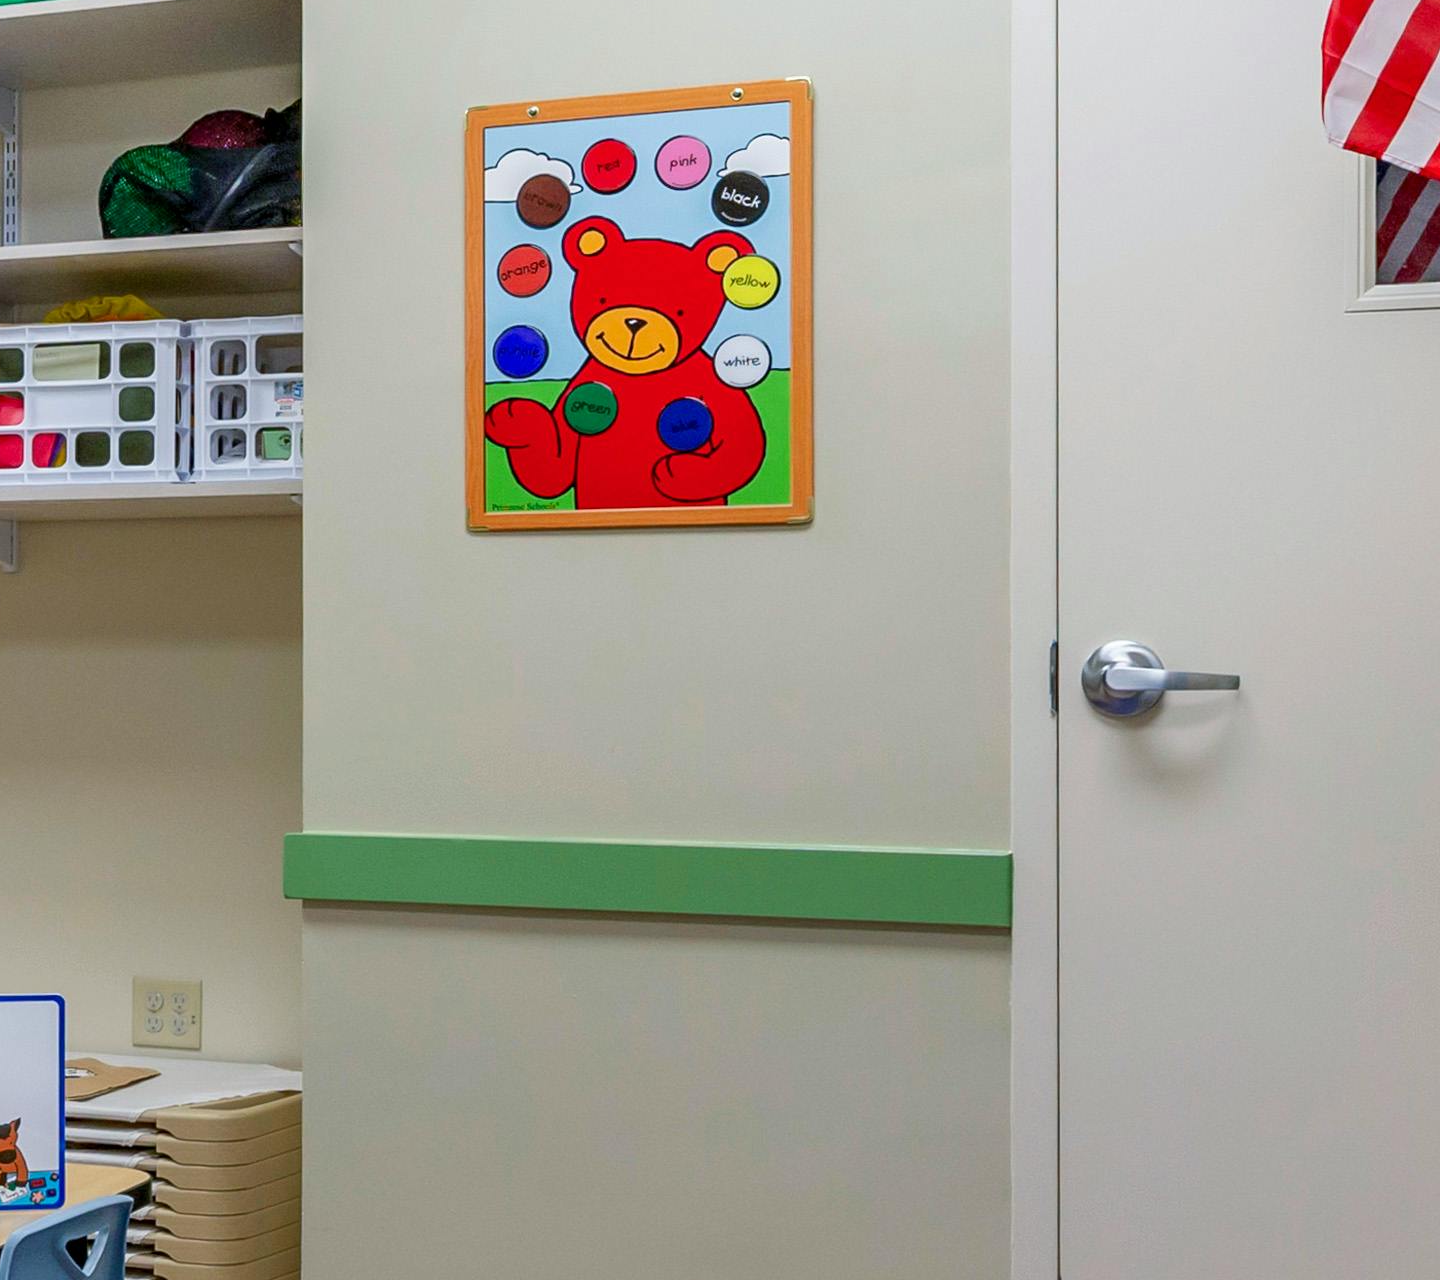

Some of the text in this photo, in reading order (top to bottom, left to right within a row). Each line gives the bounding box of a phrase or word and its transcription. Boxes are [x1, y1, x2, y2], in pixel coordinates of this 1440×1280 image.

[597, 159, 621, 173] red
[670, 153, 698, 171] pink
[525, 191, 563, 213] brown
[721, 187, 761, 210] black
[500, 259, 548, 281] orange
[729, 274, 770, 290] yellow
[723, 354, 761, 368] white
[570, 400, 611, 416] green
